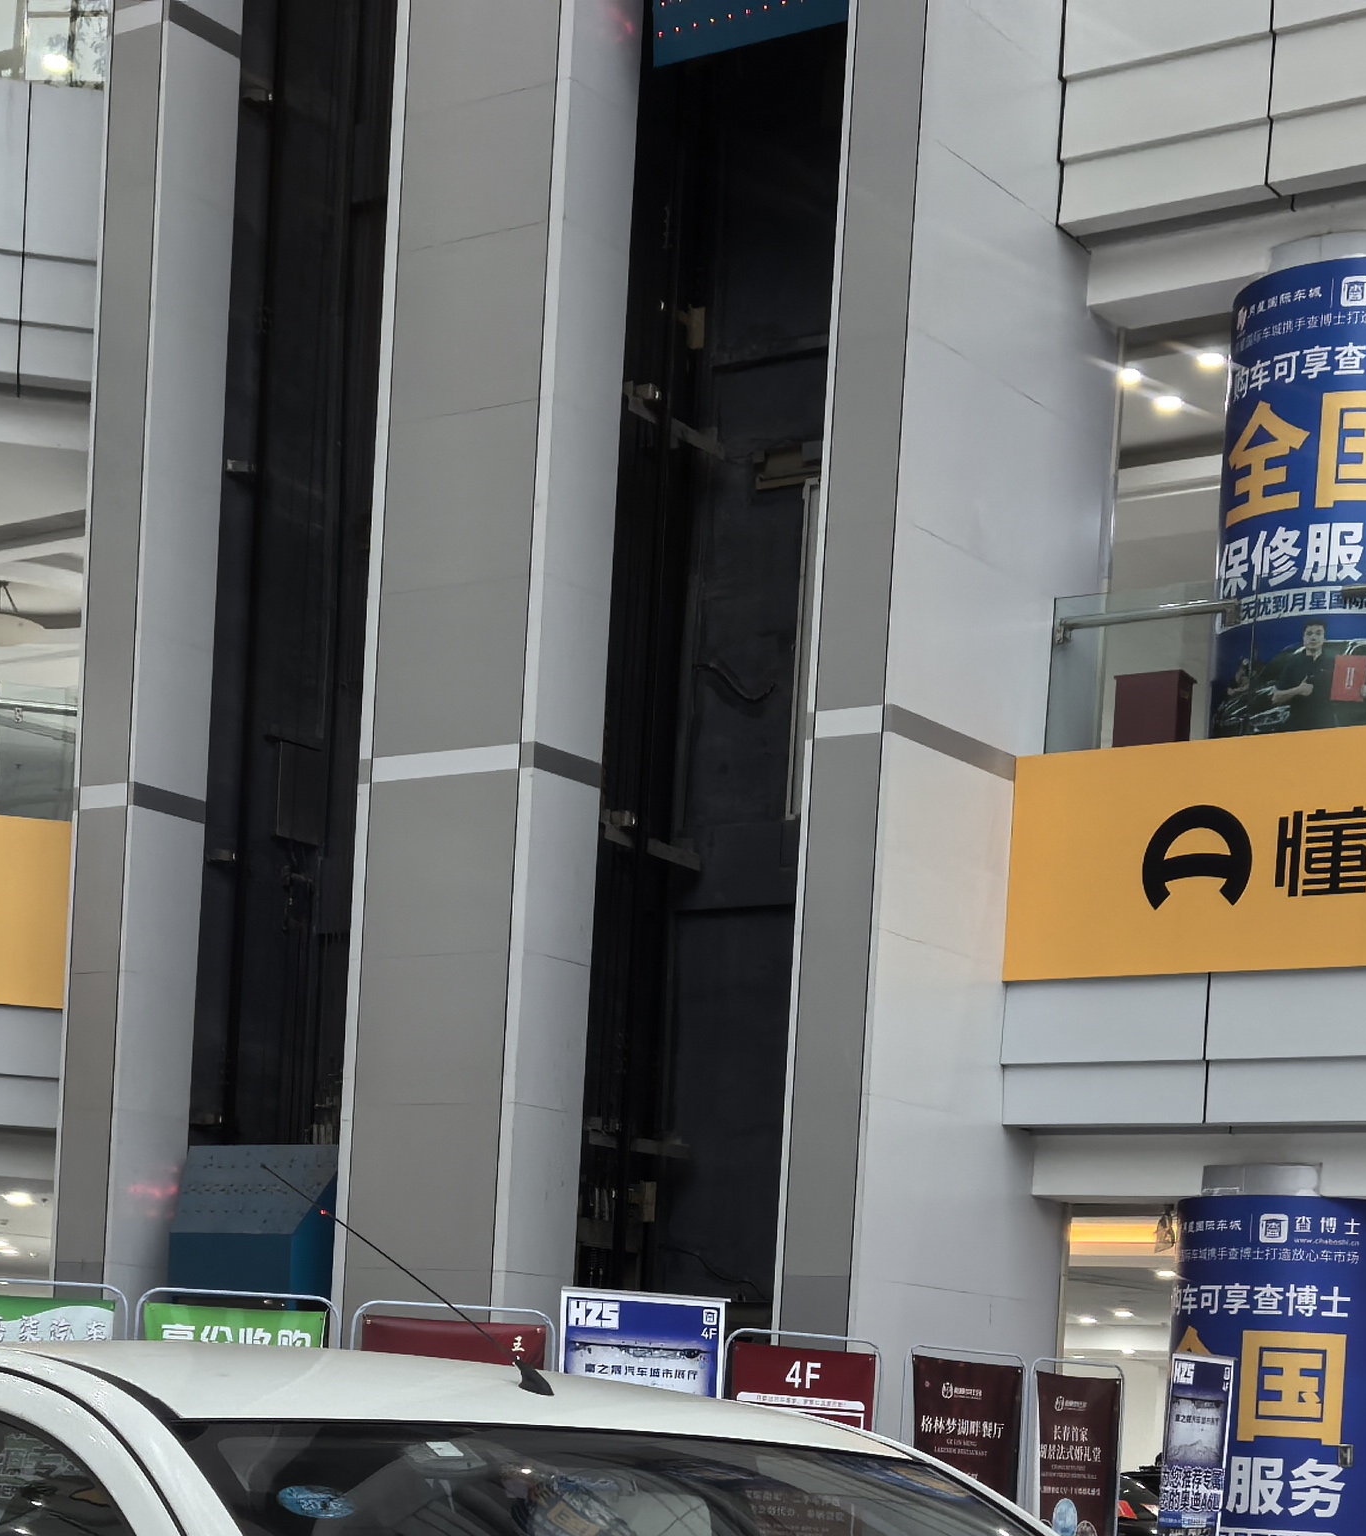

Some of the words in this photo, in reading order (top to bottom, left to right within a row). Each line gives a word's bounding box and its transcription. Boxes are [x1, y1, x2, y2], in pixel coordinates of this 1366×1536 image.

[1293, 1216, 1361, 1236] 查博士
[568, 1299, 620, 1330] HZS
[701, 1328, 717, 1340] 4F
[785, 1360, 822, 1389] 4F
[920, 1415, 1005, 1439] 格林梦湖畔餐厅
[1053, 1424, 1089, 1442] 长春首家
[1225, 1456, 1345, 1518] 服务
